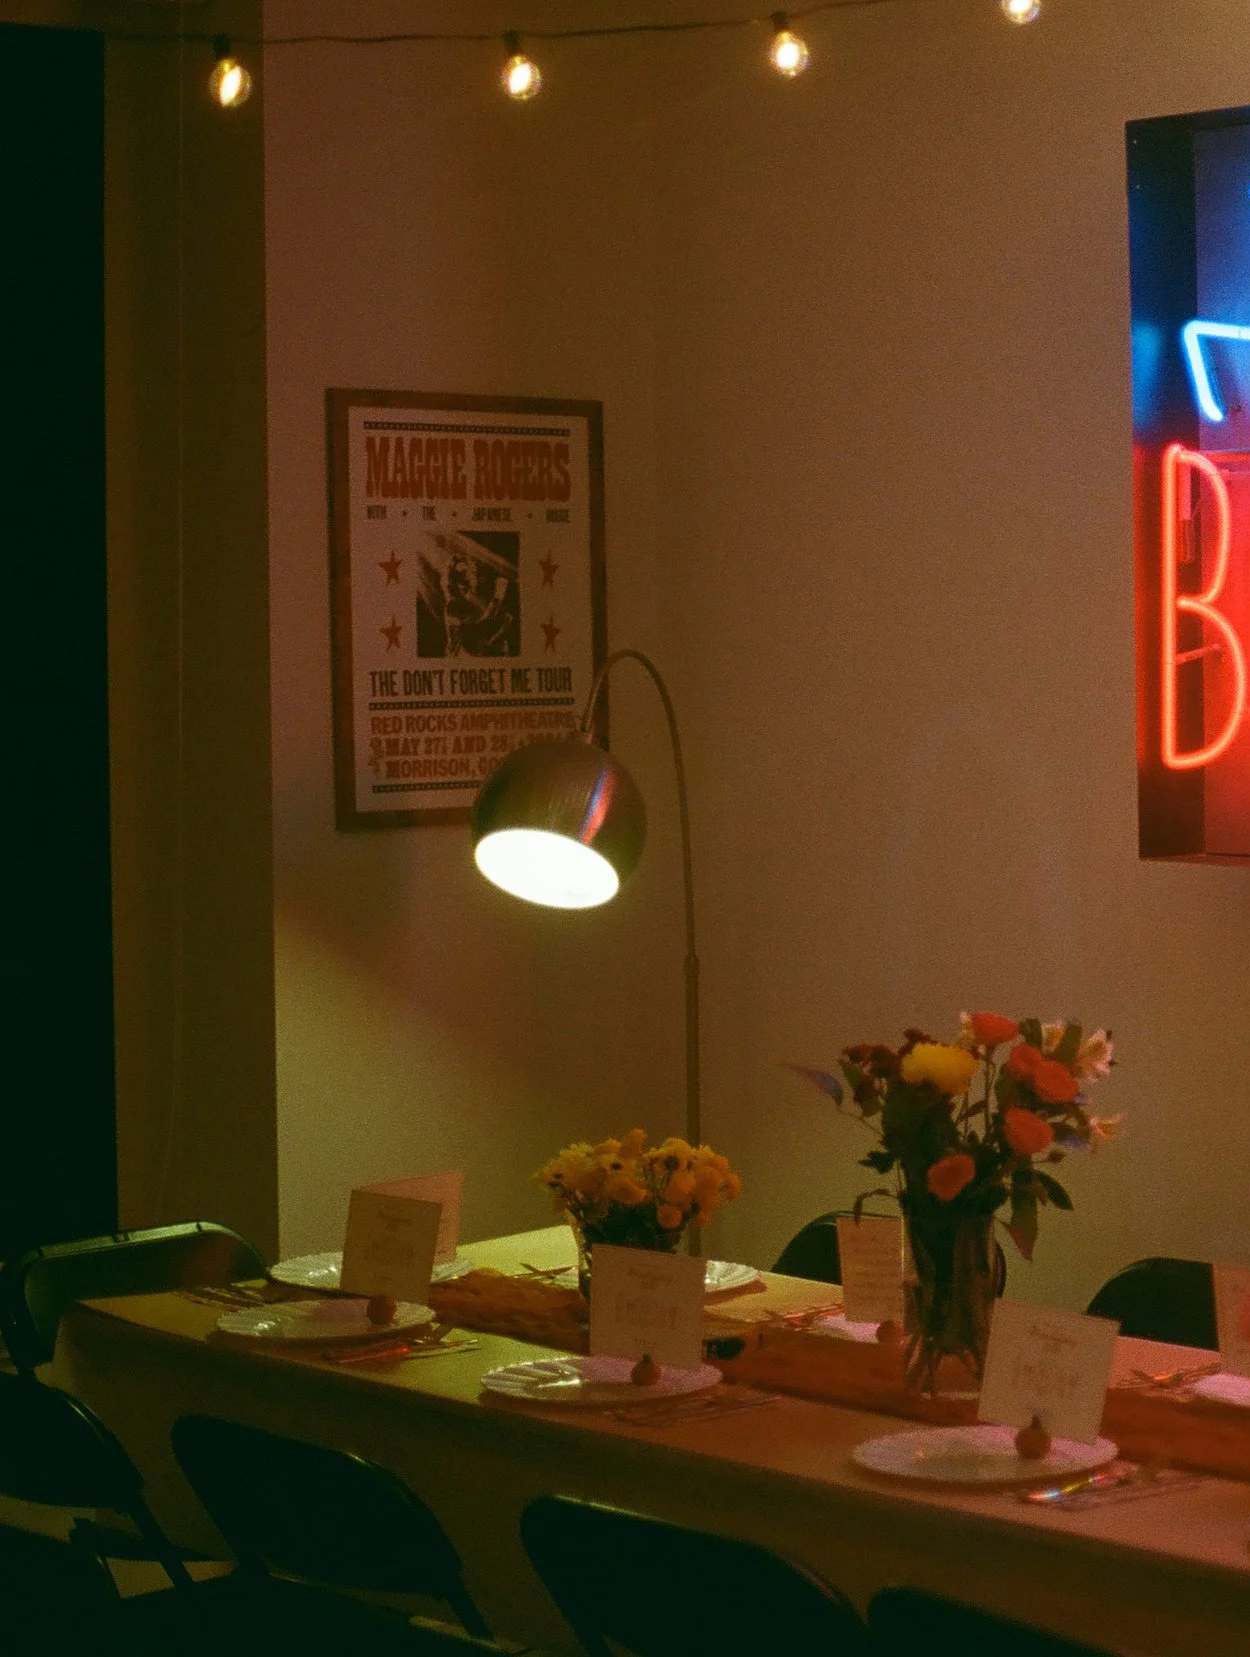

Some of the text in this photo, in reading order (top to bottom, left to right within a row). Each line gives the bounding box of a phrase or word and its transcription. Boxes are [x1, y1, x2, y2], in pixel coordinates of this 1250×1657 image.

[366, 436, 571, 502] MAGGIE ROGERS
[422, 506, 436, 521] THE
[369, 666, 572, 697] THE DON'T FORGET ME TOUR
[371, 716, 402, 735] RED
[406, 714, 457, 734] ROCKS
[386, 738, 419, 756] MAY
[453, 735, 486, 754] AND
